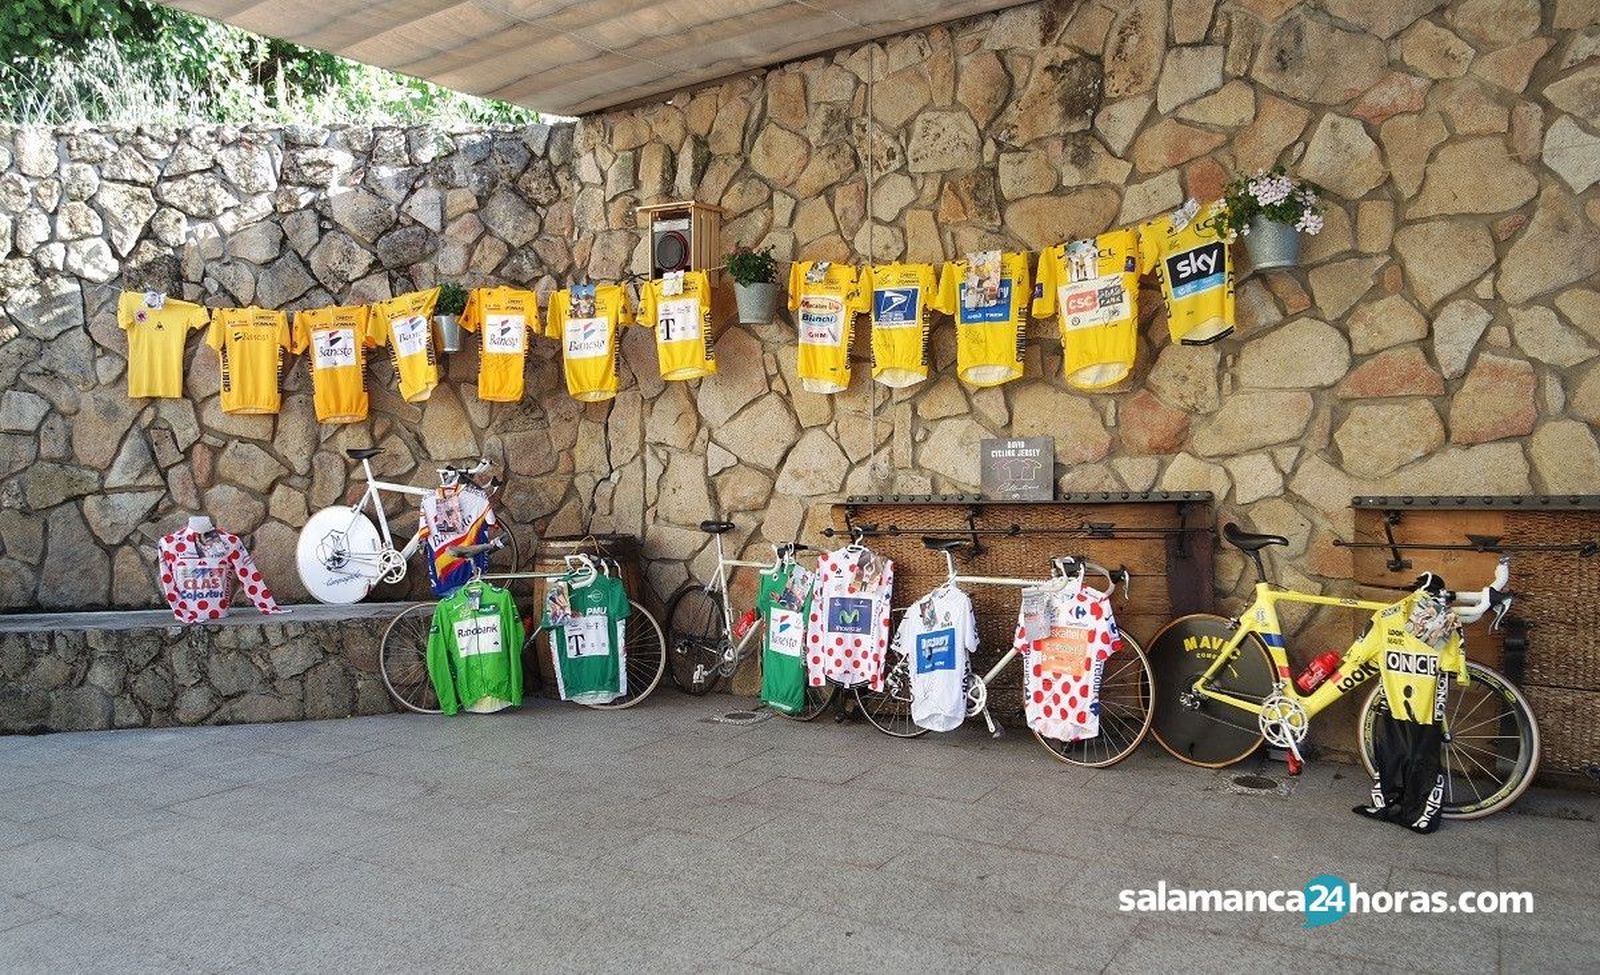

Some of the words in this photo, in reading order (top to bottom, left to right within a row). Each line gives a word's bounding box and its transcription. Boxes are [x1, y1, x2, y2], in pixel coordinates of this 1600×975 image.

[1195, 218, 1216, 232] LC
[1176, 248, 1218, 279] sky
[802, 312, 835, 323] Bianchi
[659, 318, 676, 341] T
[1016, 448, 1041, 457] JERSEY
[585, 606, 608, 616] PMU
[567, 633, 586, 657] T
[1386, 651, 1437, 677] ONCE
[1336, 659, 1380, 695] LOOK
